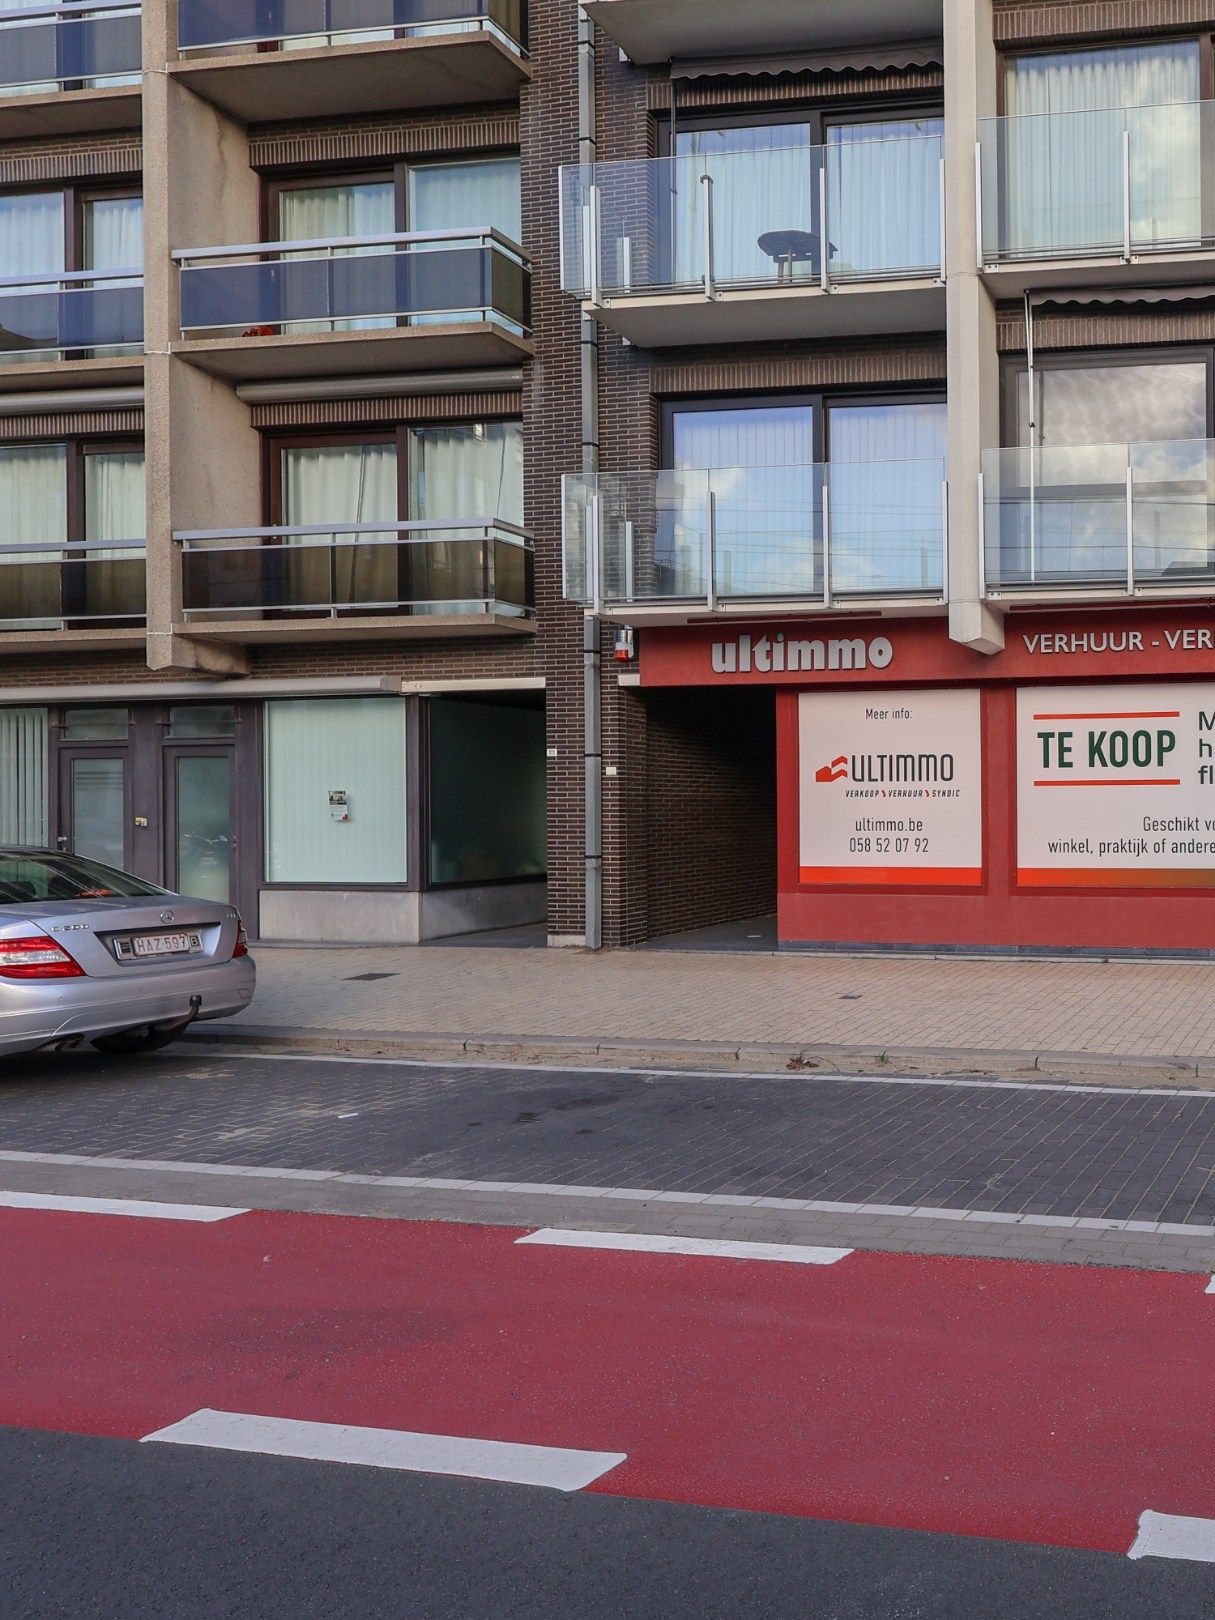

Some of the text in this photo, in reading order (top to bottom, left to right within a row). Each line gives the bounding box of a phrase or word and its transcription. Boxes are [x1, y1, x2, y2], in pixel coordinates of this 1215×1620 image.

[1023, 631, 1144, 654] VERHUUR
[711, 632, 893, 673] ultimmo
[865, 707, 913, 720] Meer info:
[1037, 730, 1176, 768] TE KOOP
[851, 754, 954, 782] ULTIMMO
[845, 789, 960, 798] VERKOOP VERHUUR SYNDIC
[855, 817, 923, 832] ultimmo.be
[1142, 816, 1200, 832] Geschikt
[849, 838, 929, 853] 058 52 07 92
[1048, 839, 1094, 855] winkel,
[1098, 839, 1149, 857] praktijk
[1153, 839, 1167, 854] of
